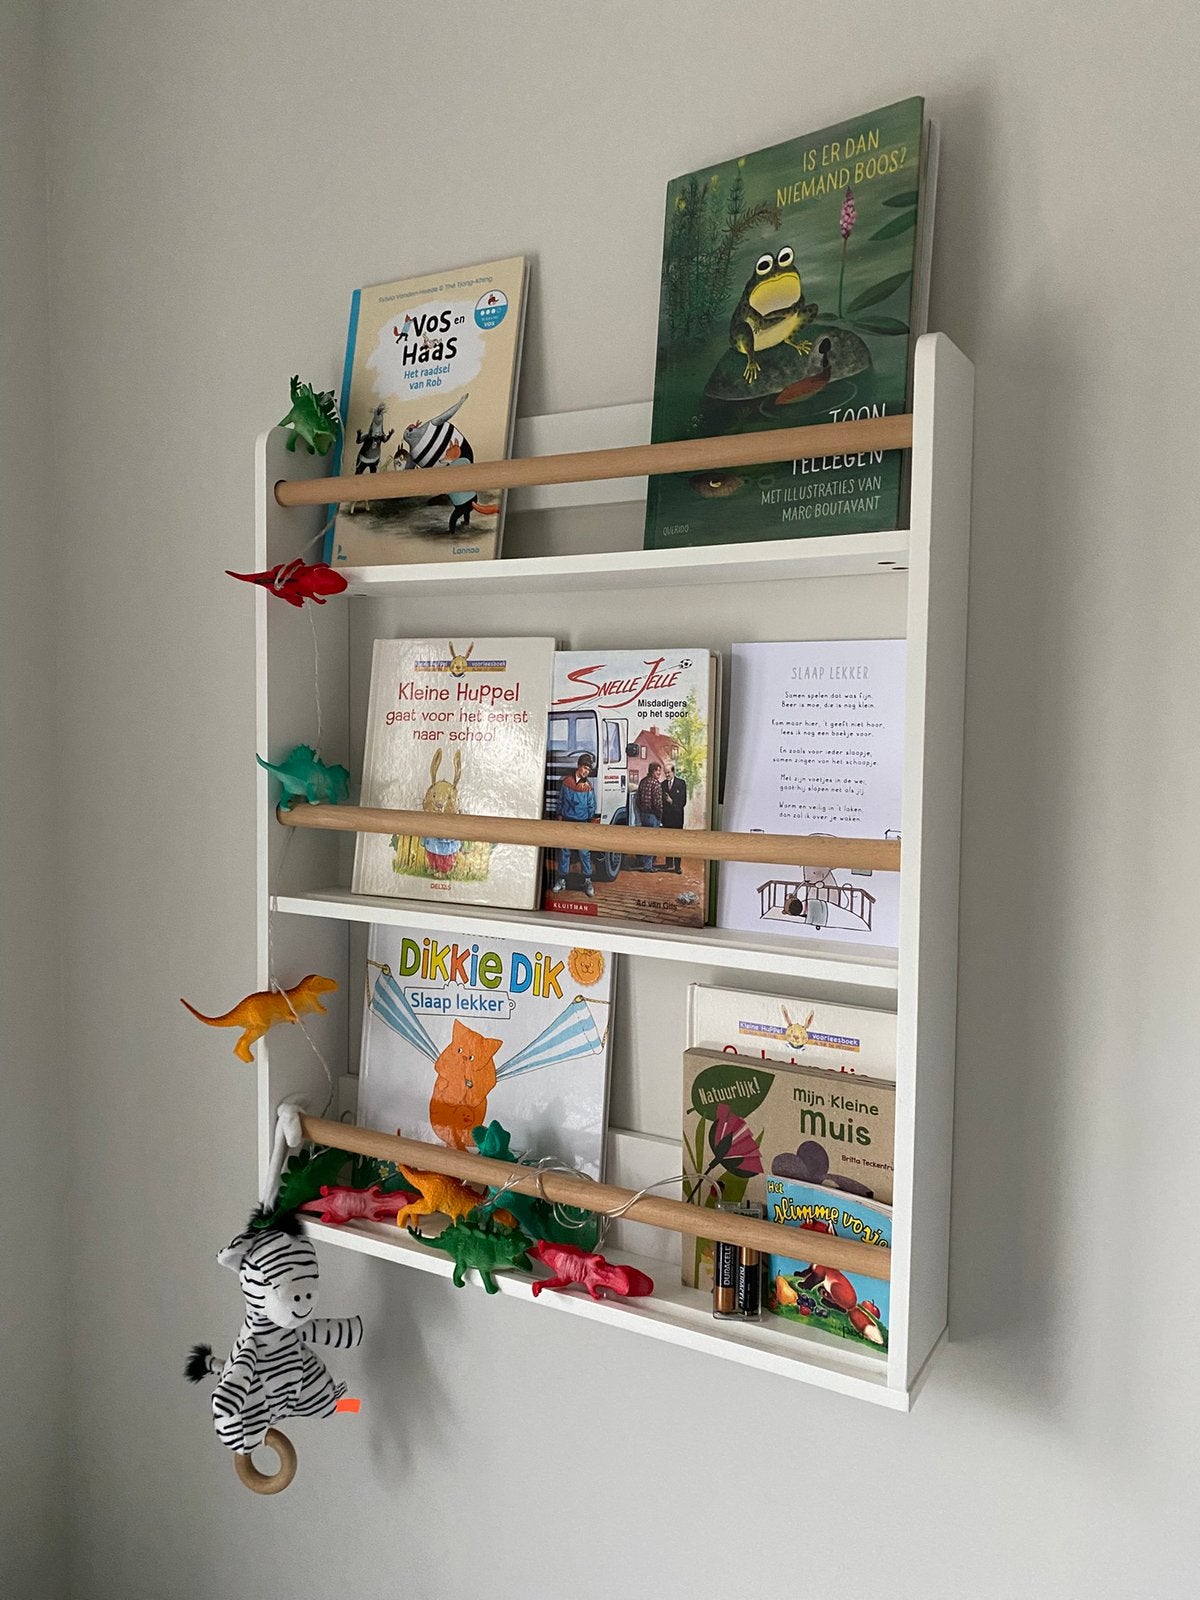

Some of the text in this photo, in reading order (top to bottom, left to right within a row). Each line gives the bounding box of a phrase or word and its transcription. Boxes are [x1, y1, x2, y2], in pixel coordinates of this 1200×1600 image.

[803, 128, 879, 173] IS ER DAN
[776, 147, 907, 208] NIEMAND BOOS?
[454, 315, 465, 325] en
[404, 364, 451, 380] Het raadsel
[409, 378, 442, 390] van Rob
[761, 475, 882, 506] MET ILLUSTRATIES VAN
[782, 496, 881, 523] MARC BOUTAVANT
[662, 524, 689, 537] QUERIDO
[791, 666, 869, 680] SLAAP LEKKER
[398, 682, 520, 706] Kleine Huppel
[784, 691, 806, 699] Samen
[807, 692, 829, 701] spelen
[637, 699, 687, 710] Misdadigers
[385, 708, 528, 725] gaat voor het eerst
[637, 709, 689, 720] op het spoor
[830, 720, 849, 729] geeft
[413, 727, 497, 742] naar school
[803, 730, 815, 738] nog
[831, 730, 854, 738] boekje
[808, 776, 833, 785] voetjes
[808, 785, 830, 793] slapen
[779, 801, 797, 809] Warm
[808, 804, 827, 812] veilig
[553, 903, 589, 912] KLUITMAN
[411, 992, 504, 1013] Slaap lekker
[740, 1022, 859, 1046] Kleine Huppel voorleesboek
[698, 1076, 761, 1105] Natuurlijk!
[793, 1087, 879, 1116] mijn Kleine
[800, 1108, 872, 1146] muis
[841, 1154, 861, 1164] Britta
[767, 1180, 784, 1194] Het
[774, 1197, 839, 1225] slimme
[723, 1245, 731, 1286] DURACELL
